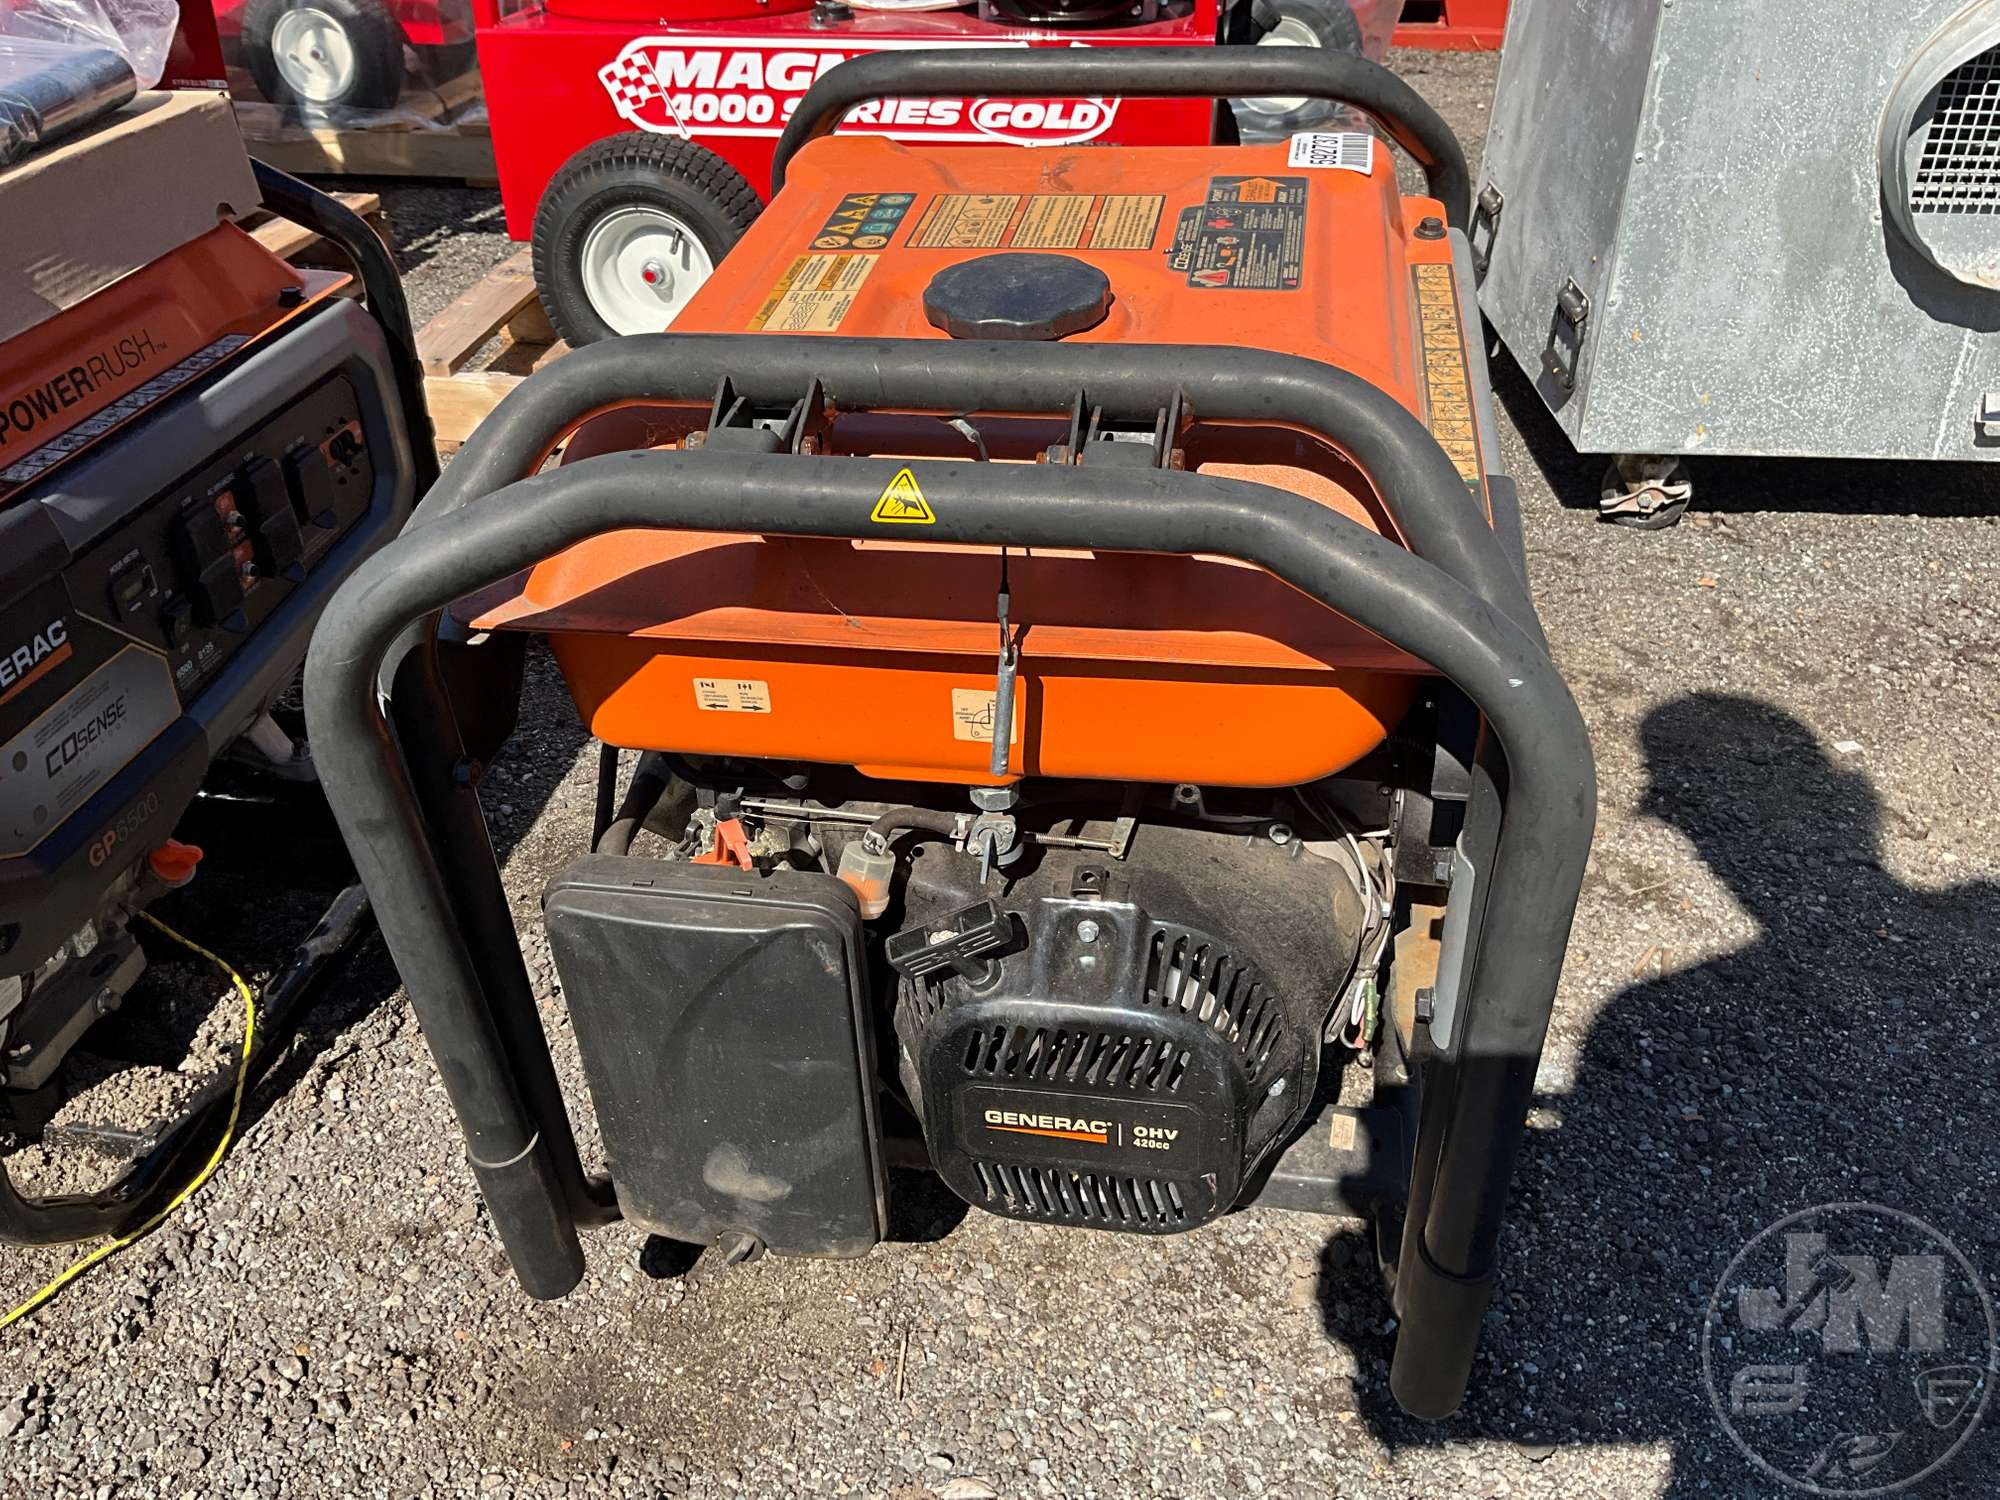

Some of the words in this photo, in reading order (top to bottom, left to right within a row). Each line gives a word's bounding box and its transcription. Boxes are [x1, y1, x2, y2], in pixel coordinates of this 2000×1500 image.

[666, 93, 775, 123] 4000
[780, 97, 961, 126] SRIES
[976, 102, 1099, 130] GOLD
[1309, 134, 1340, 167] 592737
[45, 695, 127, 778] COSENSE
[88, 790, 160, 868] GP6500
[984, 1109, 1108, 1134] GENERAC
[1133, 1125, 1179, 1141] OHV
[1133, 1137, 1171, 1151] 420cc
